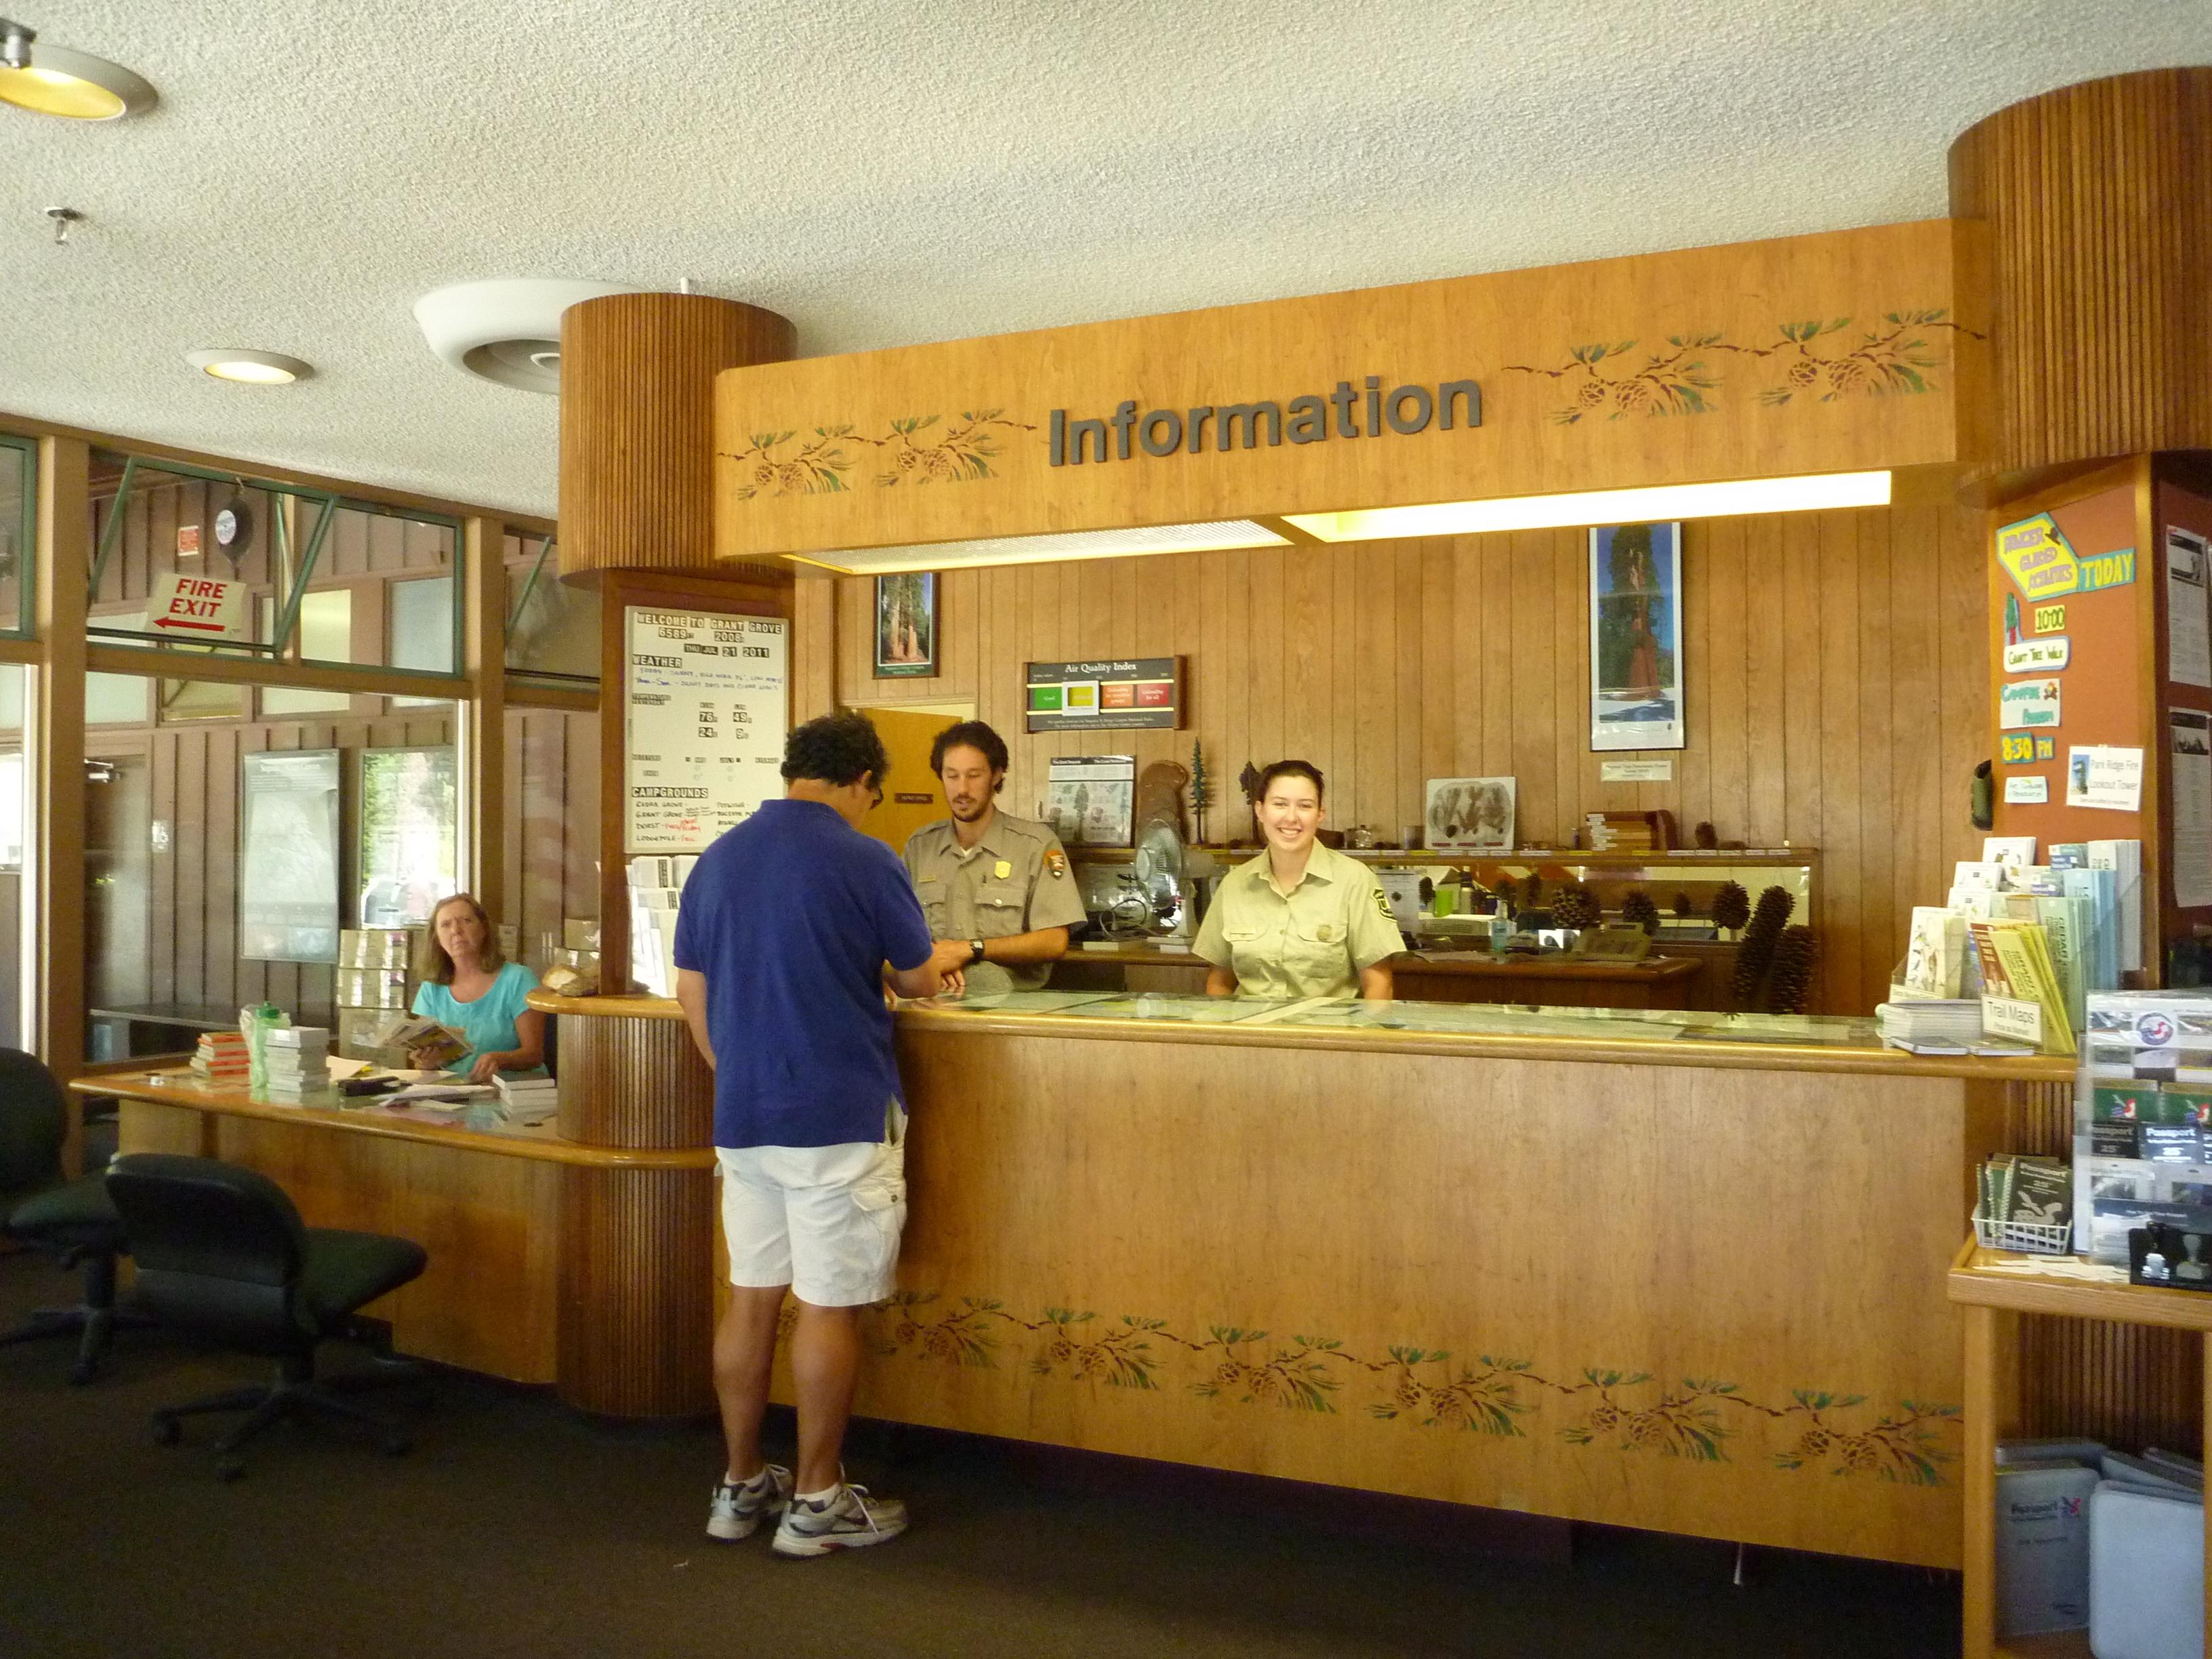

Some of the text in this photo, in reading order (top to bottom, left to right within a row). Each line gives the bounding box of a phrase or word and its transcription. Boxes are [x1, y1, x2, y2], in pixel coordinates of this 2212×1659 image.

[1048, 375, 1483, 468] Information
[2081, 552, 2135, 588] TODAY
[176, 578, 228, 599] FIRE
[169, 598, 222, 617] EXIT
[638, 613, 782, 634] WELCOME TO GRANT GROVE
[632, 654, 682, 668] WEATHER
[722, 647, 737, 657] 21
[743, 647, 770, 657] 2011
[1065, 661, 1137, 673] Air Quality Index
[632, 787, 708, 798] CAMPGROUNDS
[1988, 1001, 2035, 1026] Trail Maps
